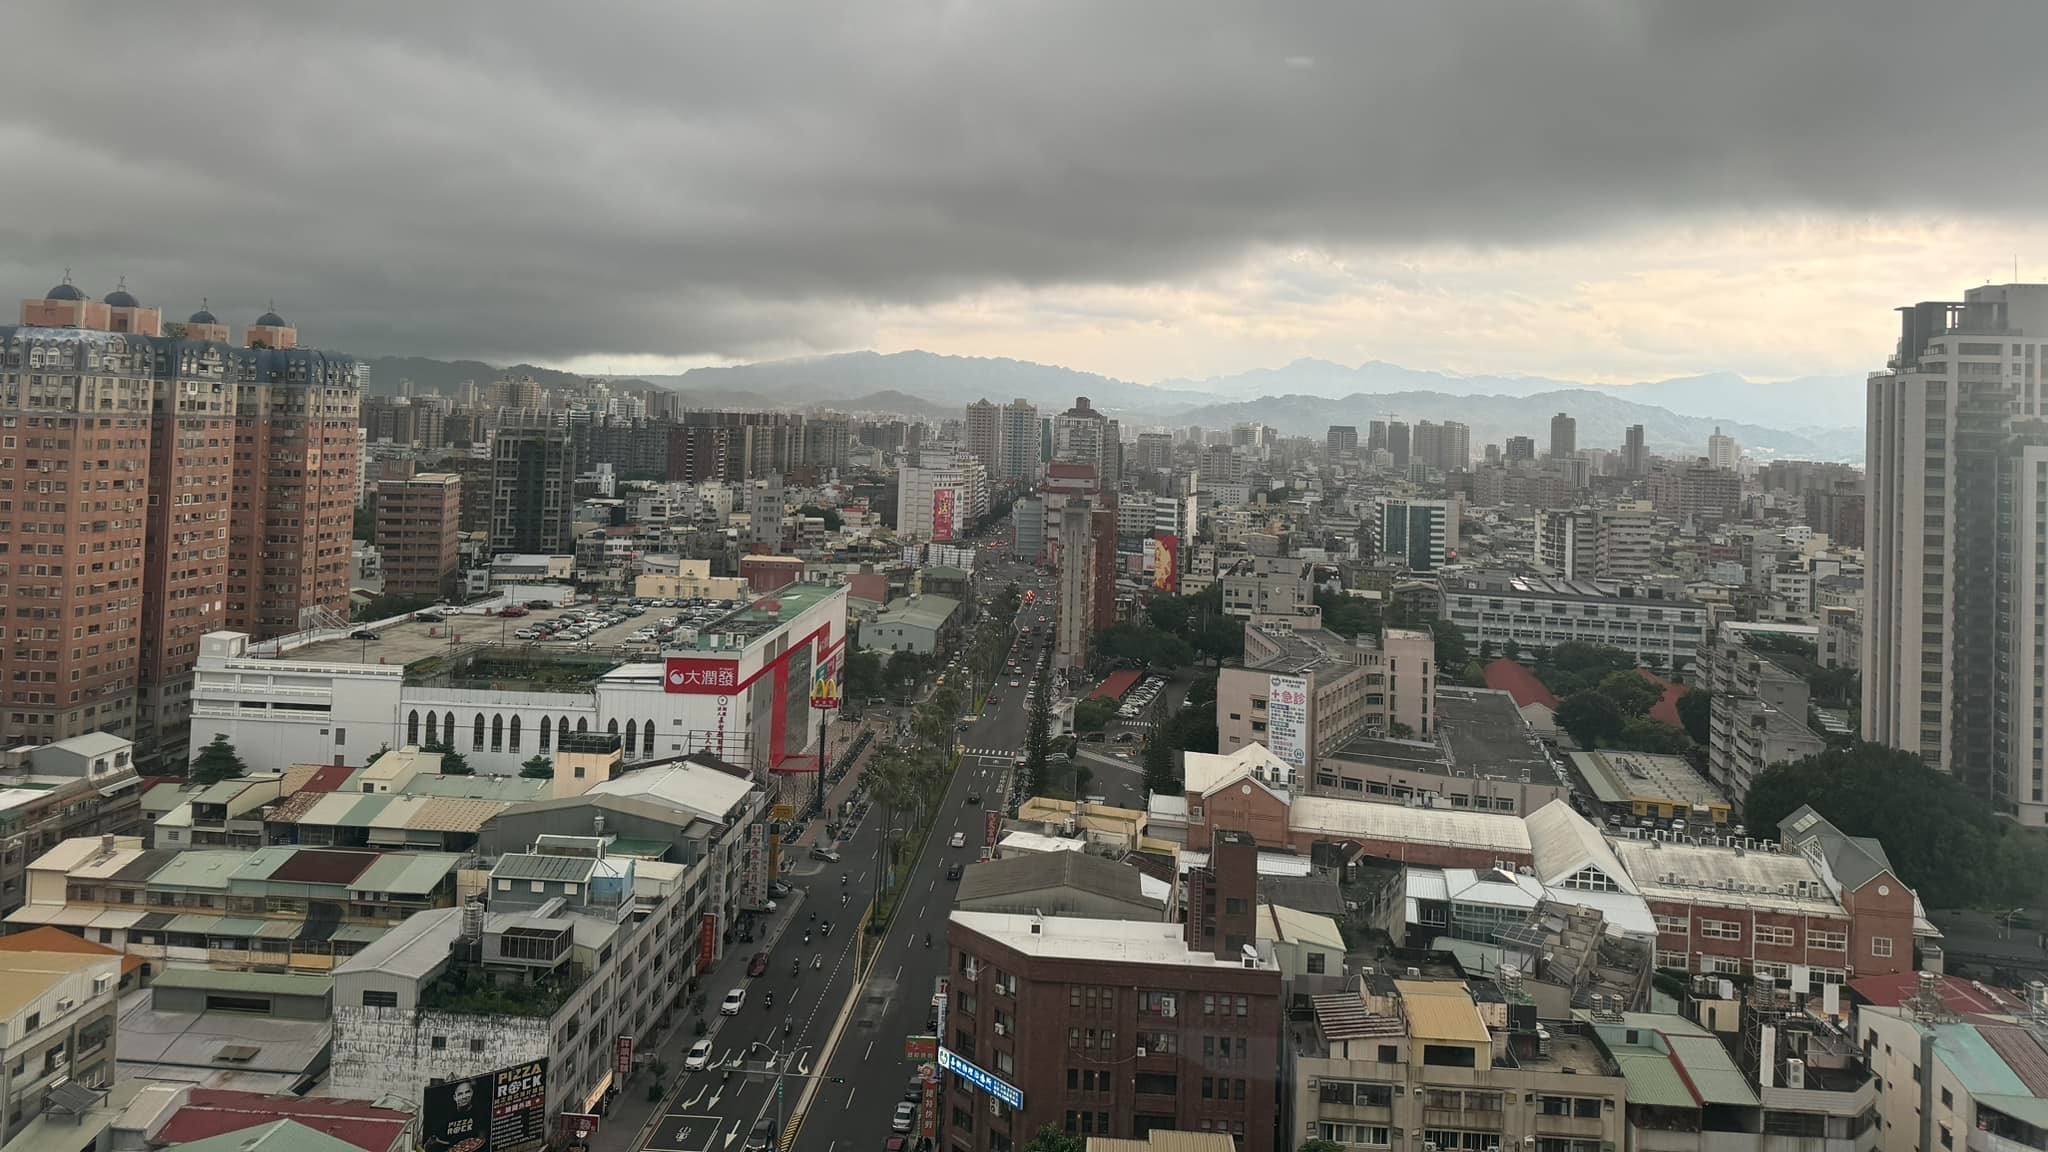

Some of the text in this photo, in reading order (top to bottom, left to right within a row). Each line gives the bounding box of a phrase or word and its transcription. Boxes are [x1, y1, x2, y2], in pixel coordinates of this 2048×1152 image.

[684, 669, 734, 686] 大潤發
[1281, 690, 1305, 704] 急診
[498, 1063, 542, 1085] PIZZA
[497, 1075, 542, 1097] ROCK
[448, 1118, 473, 1128] PIZZA
